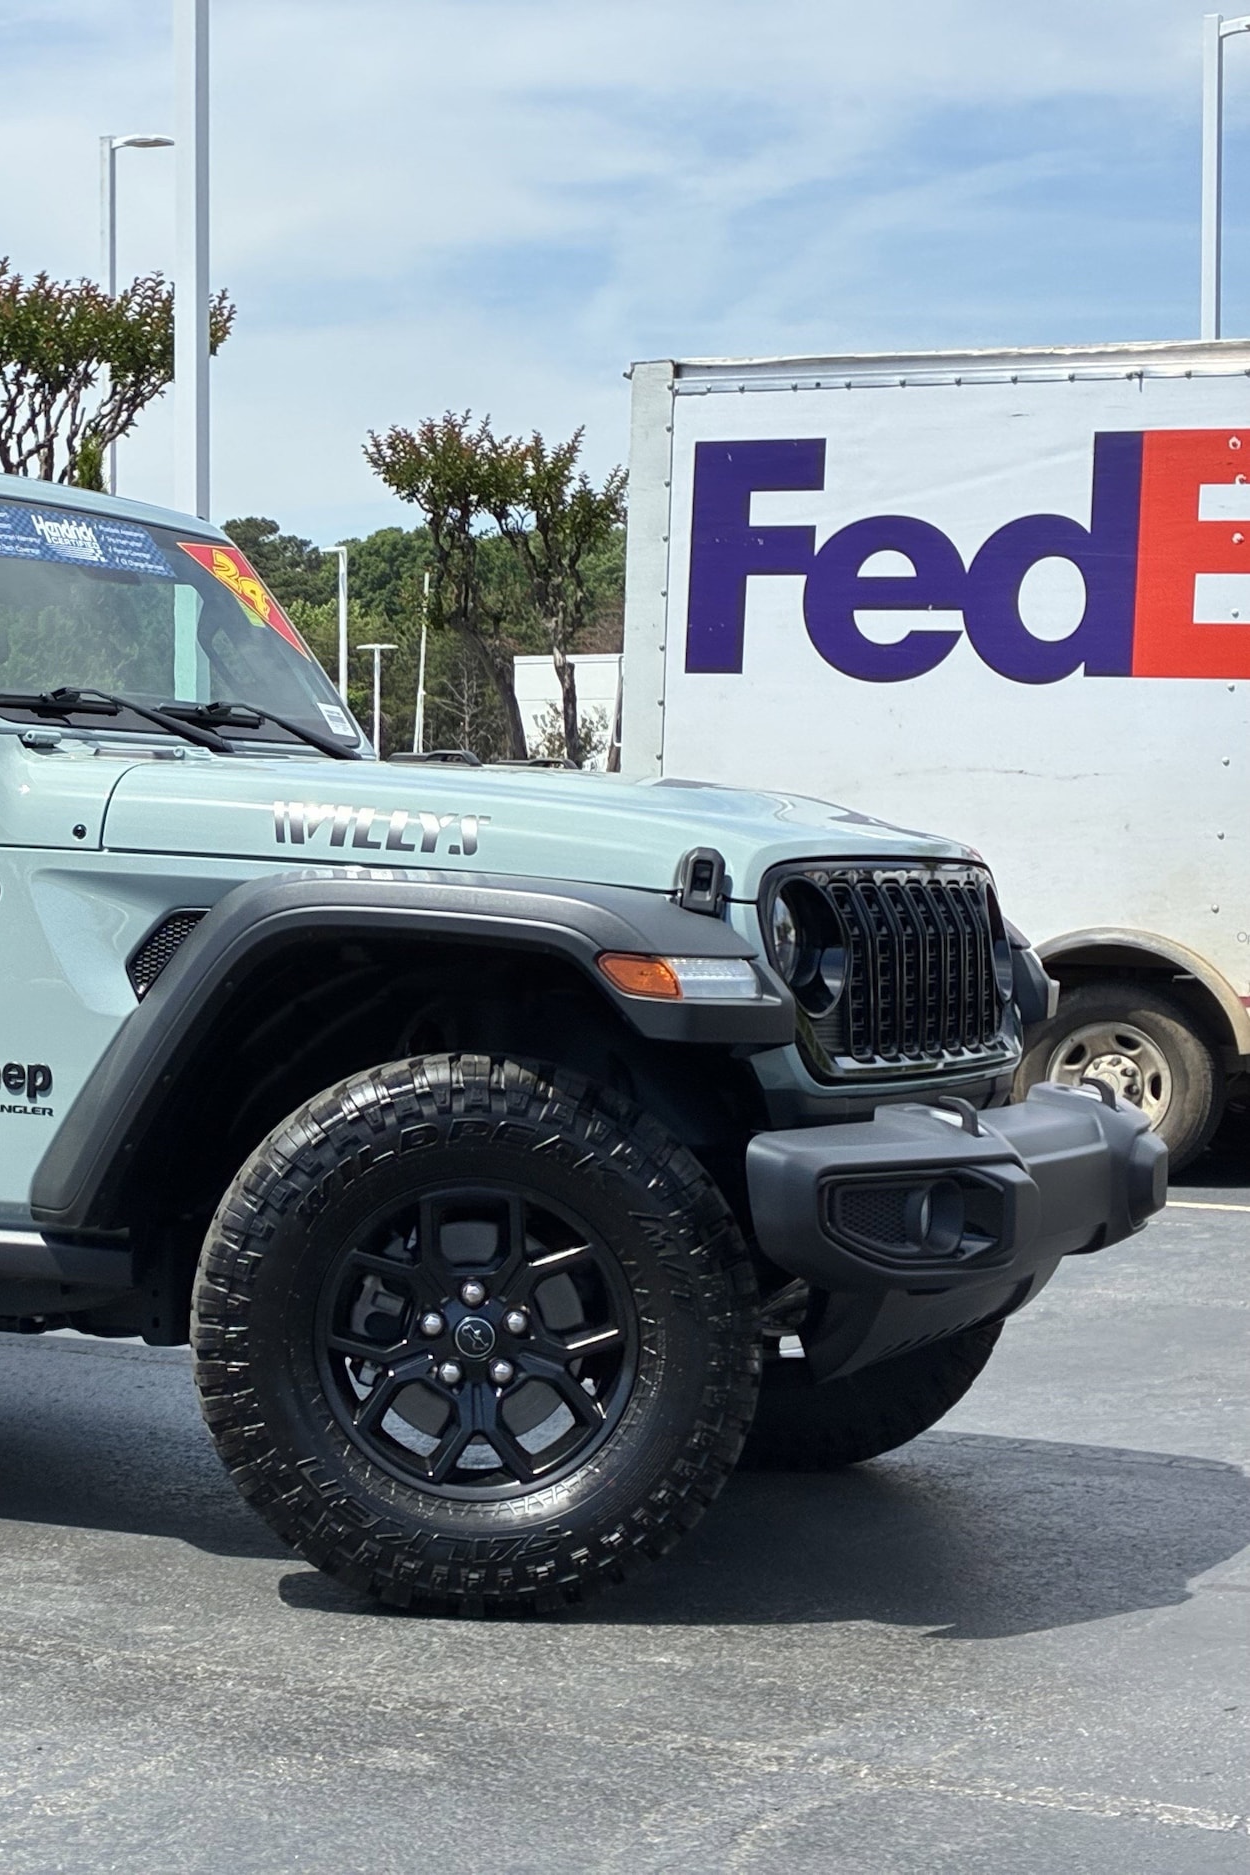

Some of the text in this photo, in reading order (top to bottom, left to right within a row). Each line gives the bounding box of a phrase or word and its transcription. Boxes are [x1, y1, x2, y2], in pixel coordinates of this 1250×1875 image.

[31, 514, 98, 543] Hendrick
[51, 536, 100, 550] CERTIFIED
[685, 429, 1250, 685] FedE
[211, 548, 271, 624] 24
[273, 800, 492, 856] WILLYS
